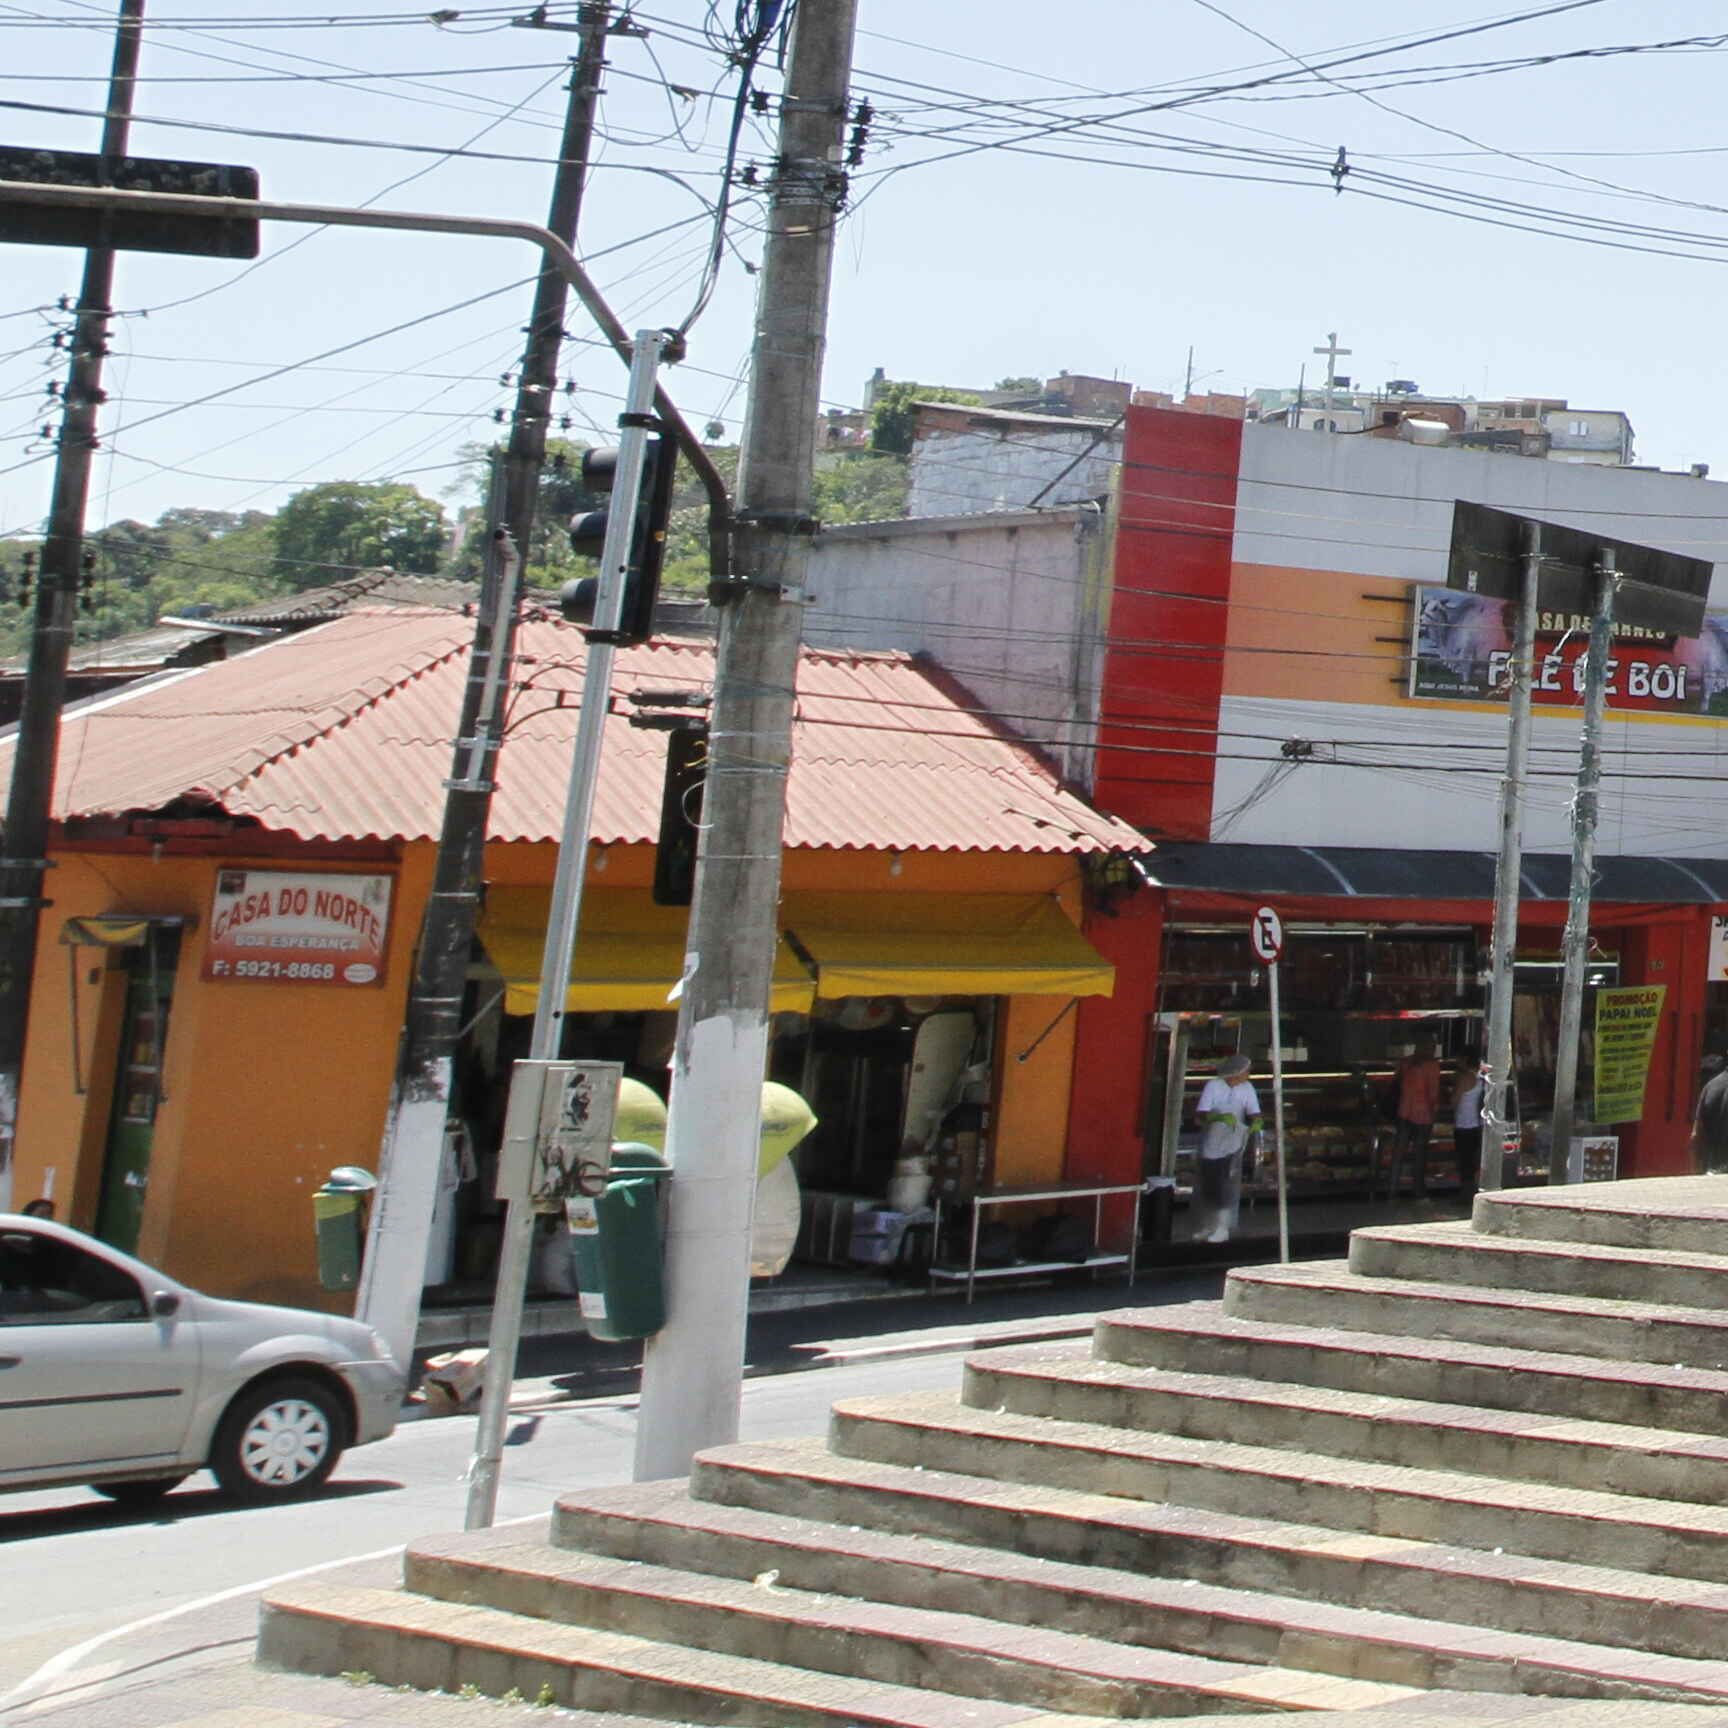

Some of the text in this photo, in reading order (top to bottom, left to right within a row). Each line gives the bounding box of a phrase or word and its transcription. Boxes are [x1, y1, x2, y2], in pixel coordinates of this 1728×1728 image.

[1628, 660, 1688, 700] BOI
[211, 887, 382, 957] CASA DO NORTE
[270, 934, 361, 951] ESPERANÇA
